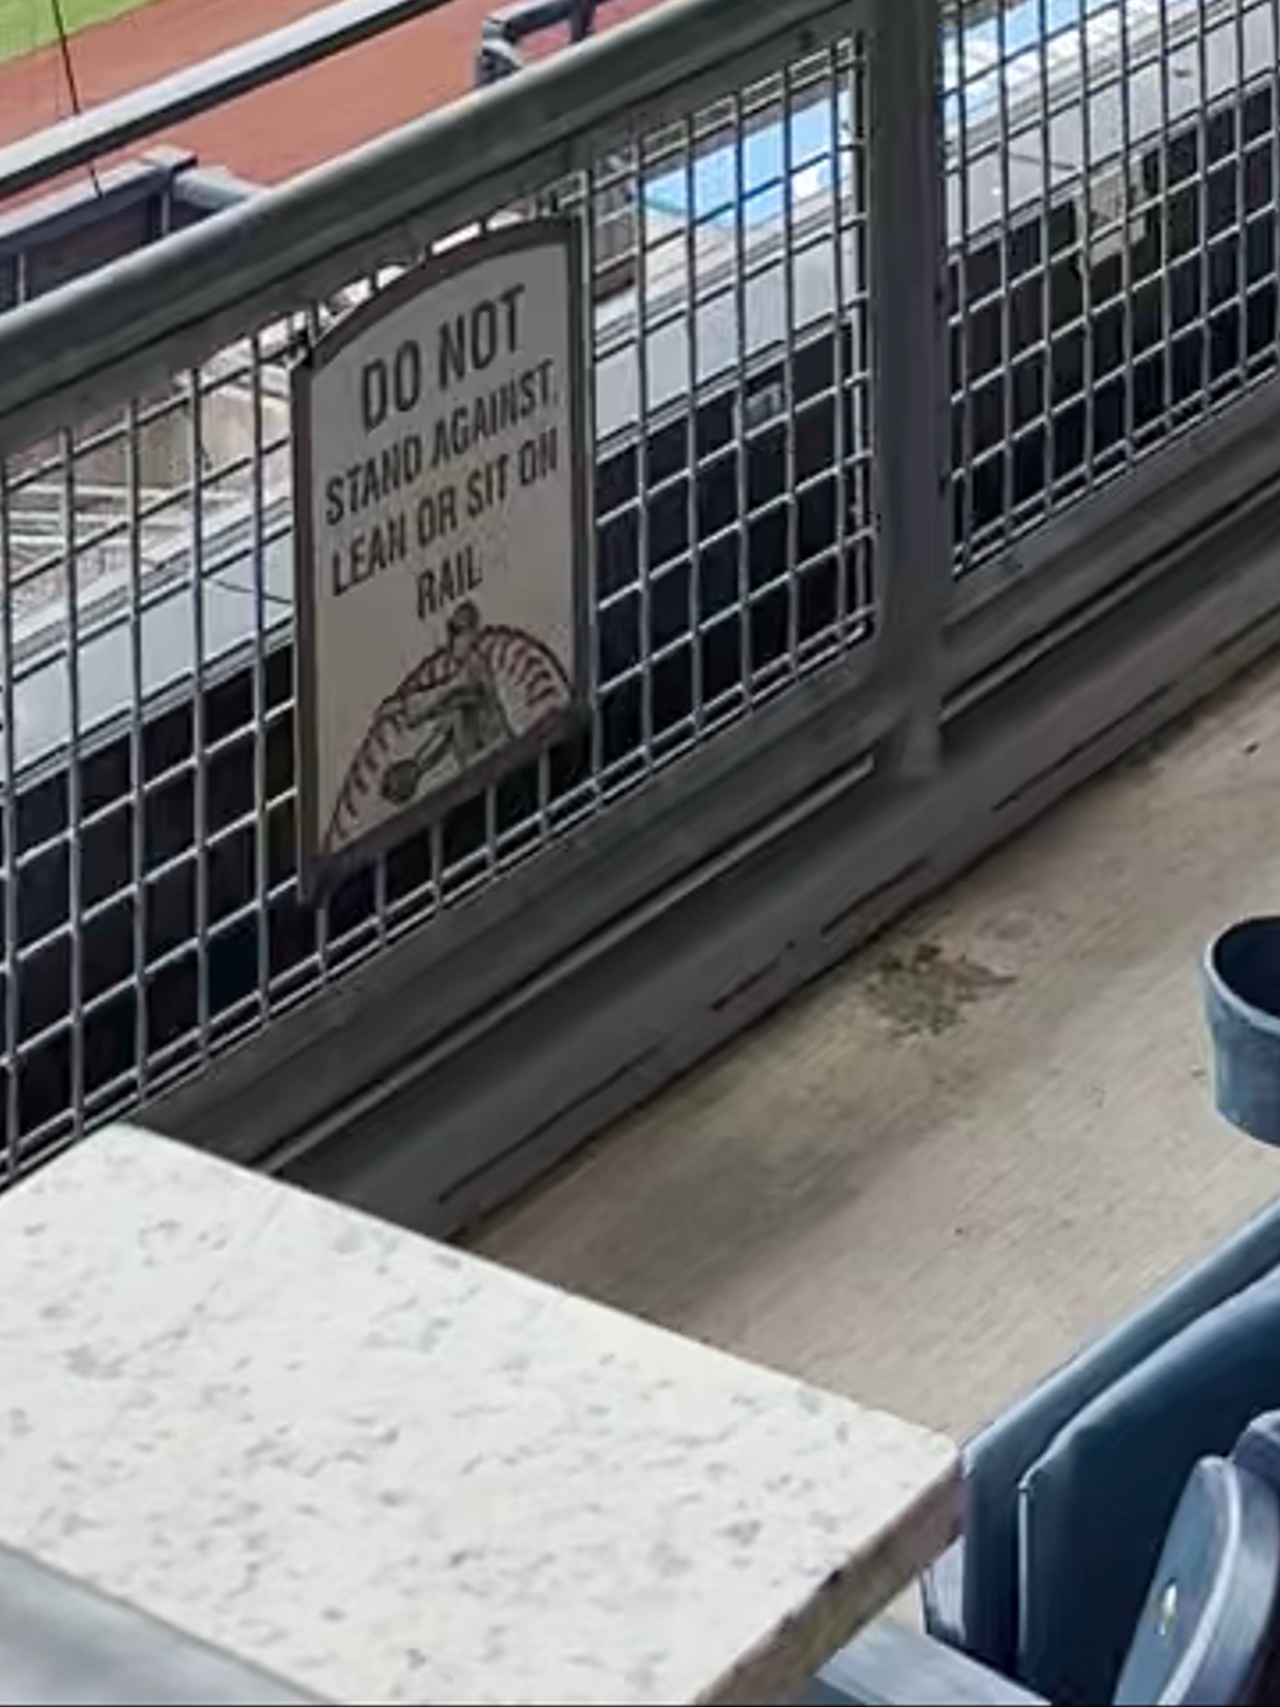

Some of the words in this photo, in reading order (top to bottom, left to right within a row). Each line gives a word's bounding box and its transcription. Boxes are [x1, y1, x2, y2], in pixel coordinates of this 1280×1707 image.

[361, 340, 421, 435] DO
[438, 282, 525, 391] NOT
[325, 434, 421, 526] STAND
[430, 357, 554, 469] AGAINST
[332, 511, 408, 598] LEAN
[417, 485, 458, 548] OR
[467, 453, 508, 519] SIT
[518, 426, 558, 486] ON
[416, 544, 483, 621] RAIL
